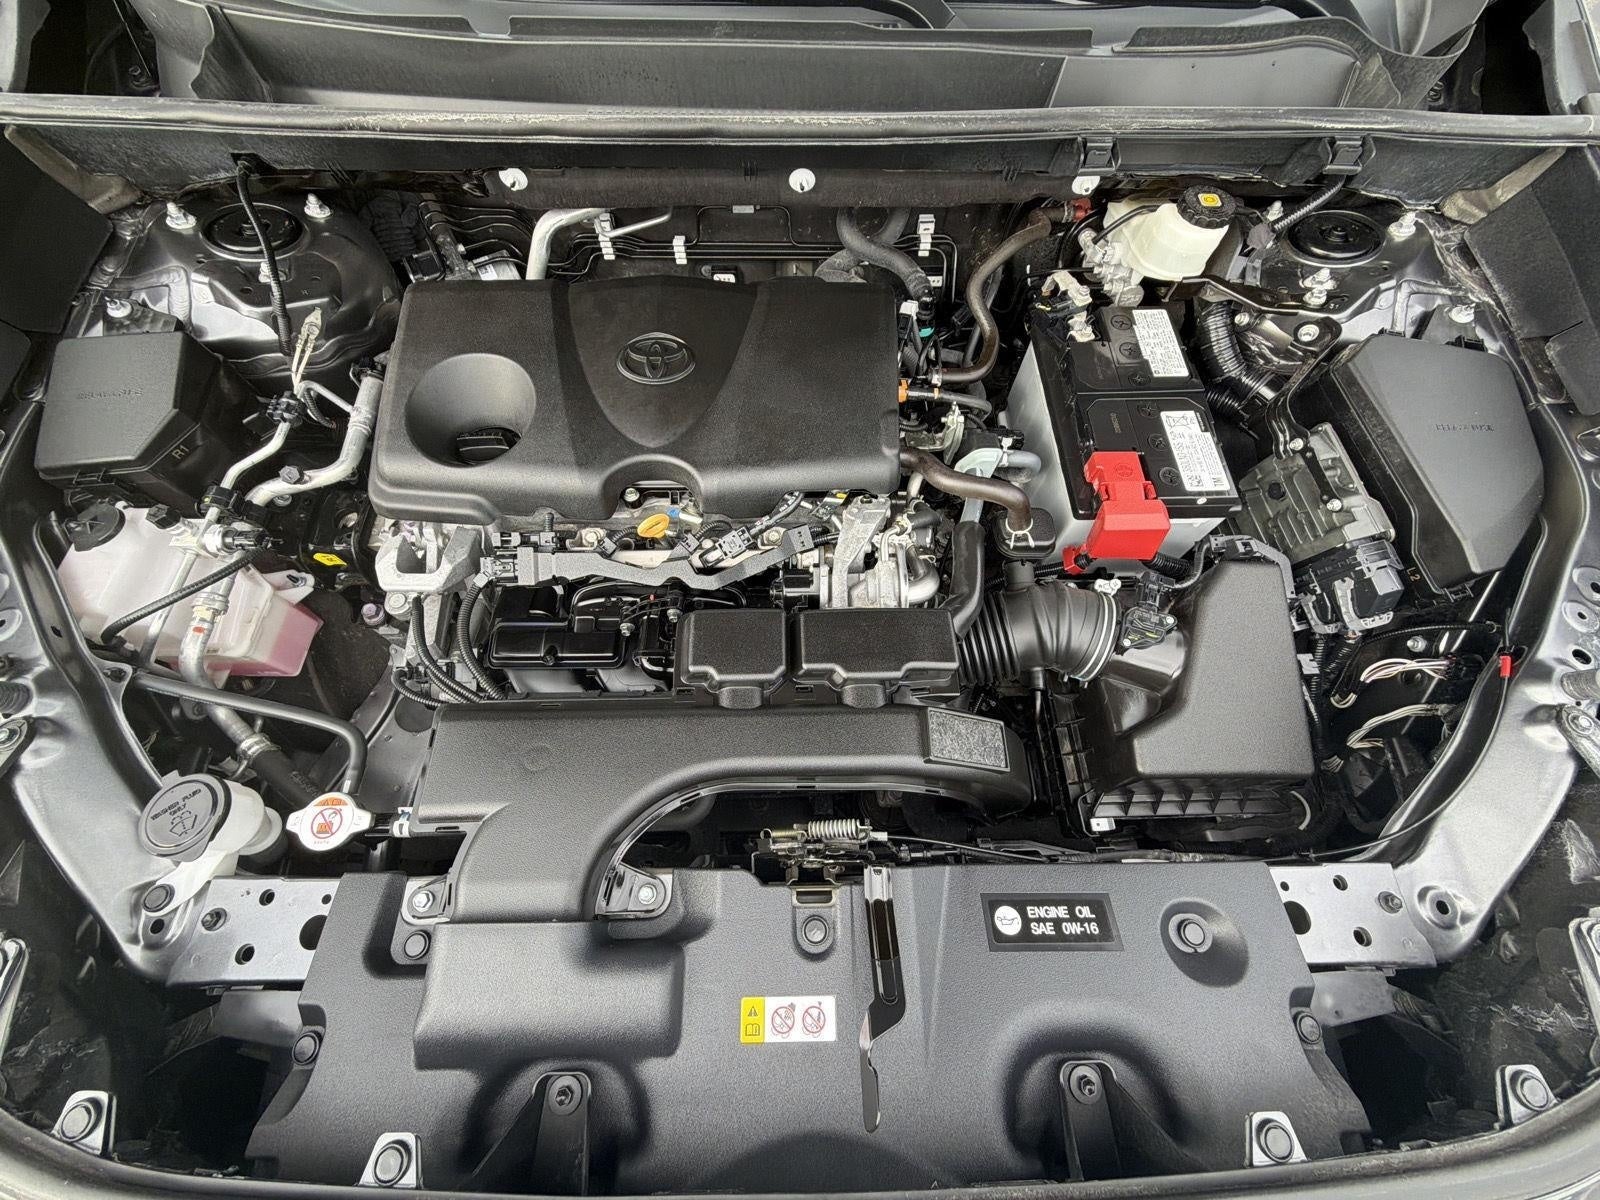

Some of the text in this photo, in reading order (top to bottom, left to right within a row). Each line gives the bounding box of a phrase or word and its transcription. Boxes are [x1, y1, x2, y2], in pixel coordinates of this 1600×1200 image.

[172, 445, 189, 460] R1
[1407, 566, 1420, 581] L2
[169, 803, 187, 816] ONLY
[1026, 906, 1096, 918] ENGINE OIL
[1030, 922, 1099, 935] SAE 0W-16
